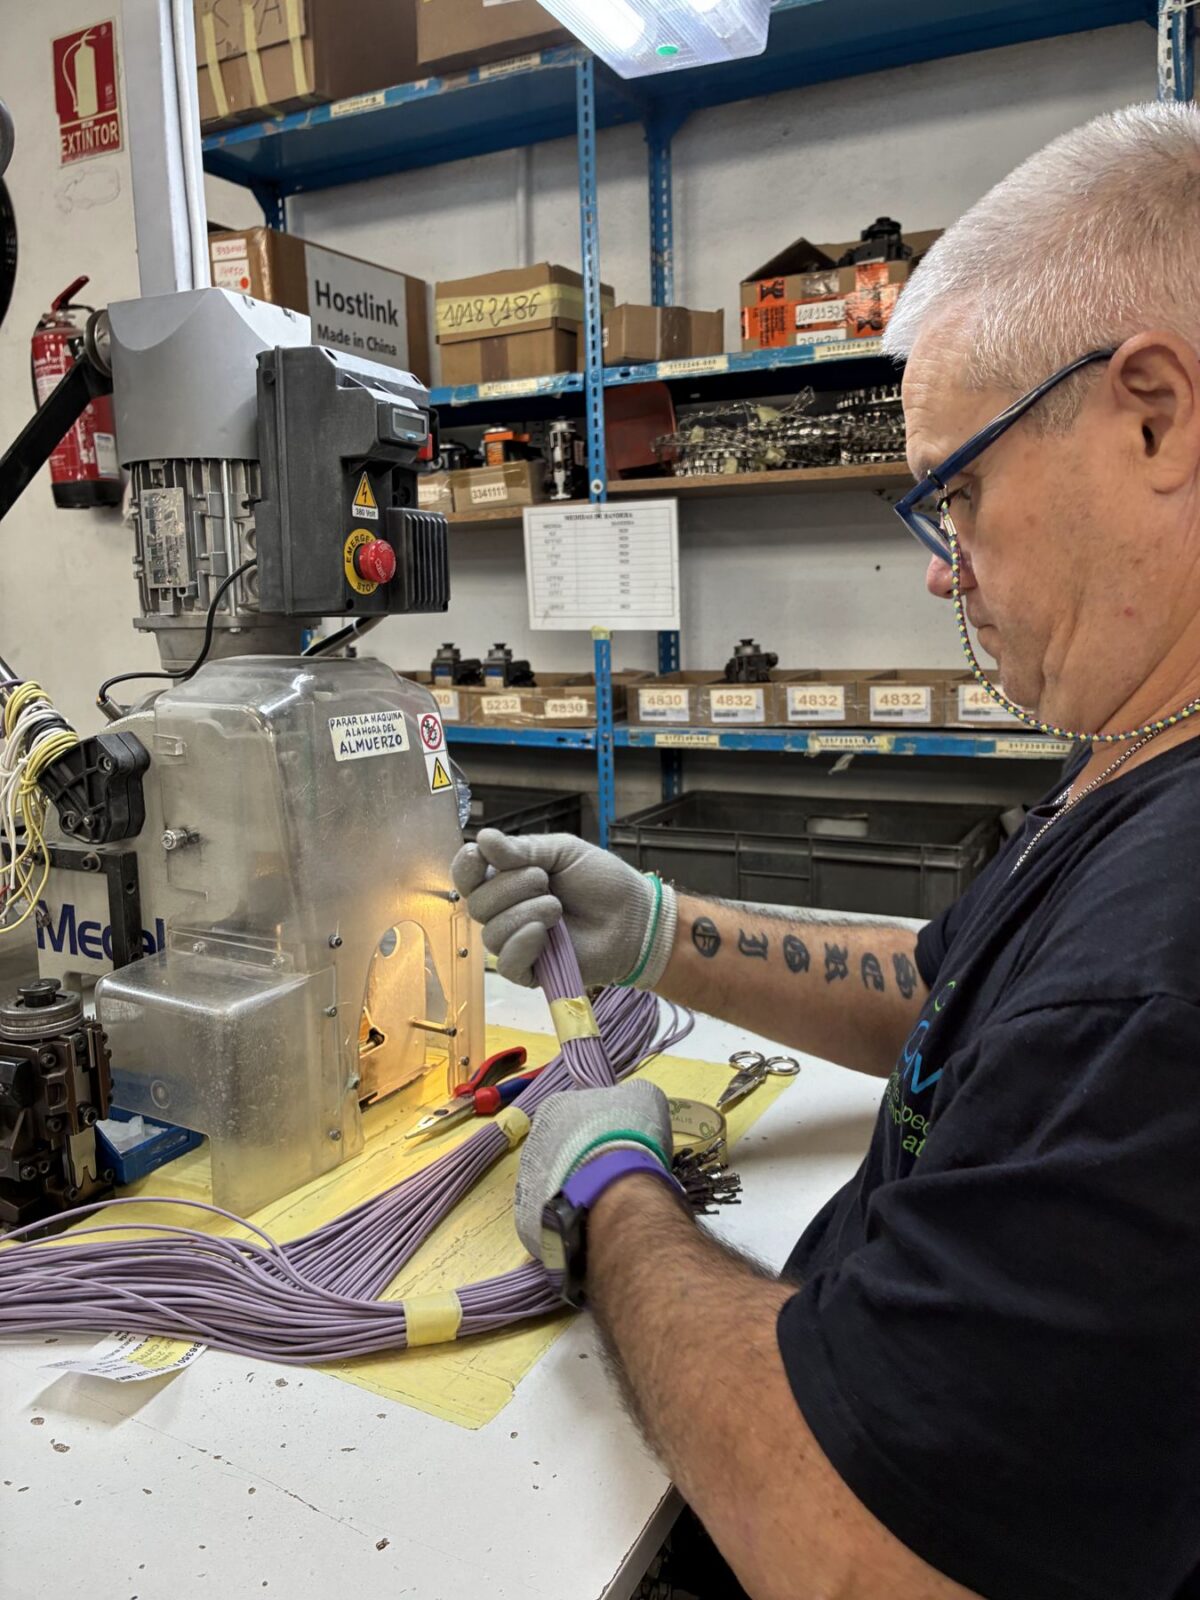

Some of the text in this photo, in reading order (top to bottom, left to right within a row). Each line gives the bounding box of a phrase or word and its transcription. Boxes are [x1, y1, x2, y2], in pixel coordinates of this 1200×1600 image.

[60, 120, 118, 156] EXTINTOR
[315, 279, 399, 328] Hostlink
[317, 323, 397, 356] Made in China
[486, 699, 518, 711] 5232
[647, 694, 682, 706] 4830
[715, 694, 753, 706] 4832
[797, 694, 838, 707] 4832
[880, 693, 922, 706] 4832
[550, 702, 584, 713] 4830
[371, 711, 403, 722] MAQUINA
[383, 724, 397, 734] DEL
[340, 734, 403, 755] ALMUERZO
